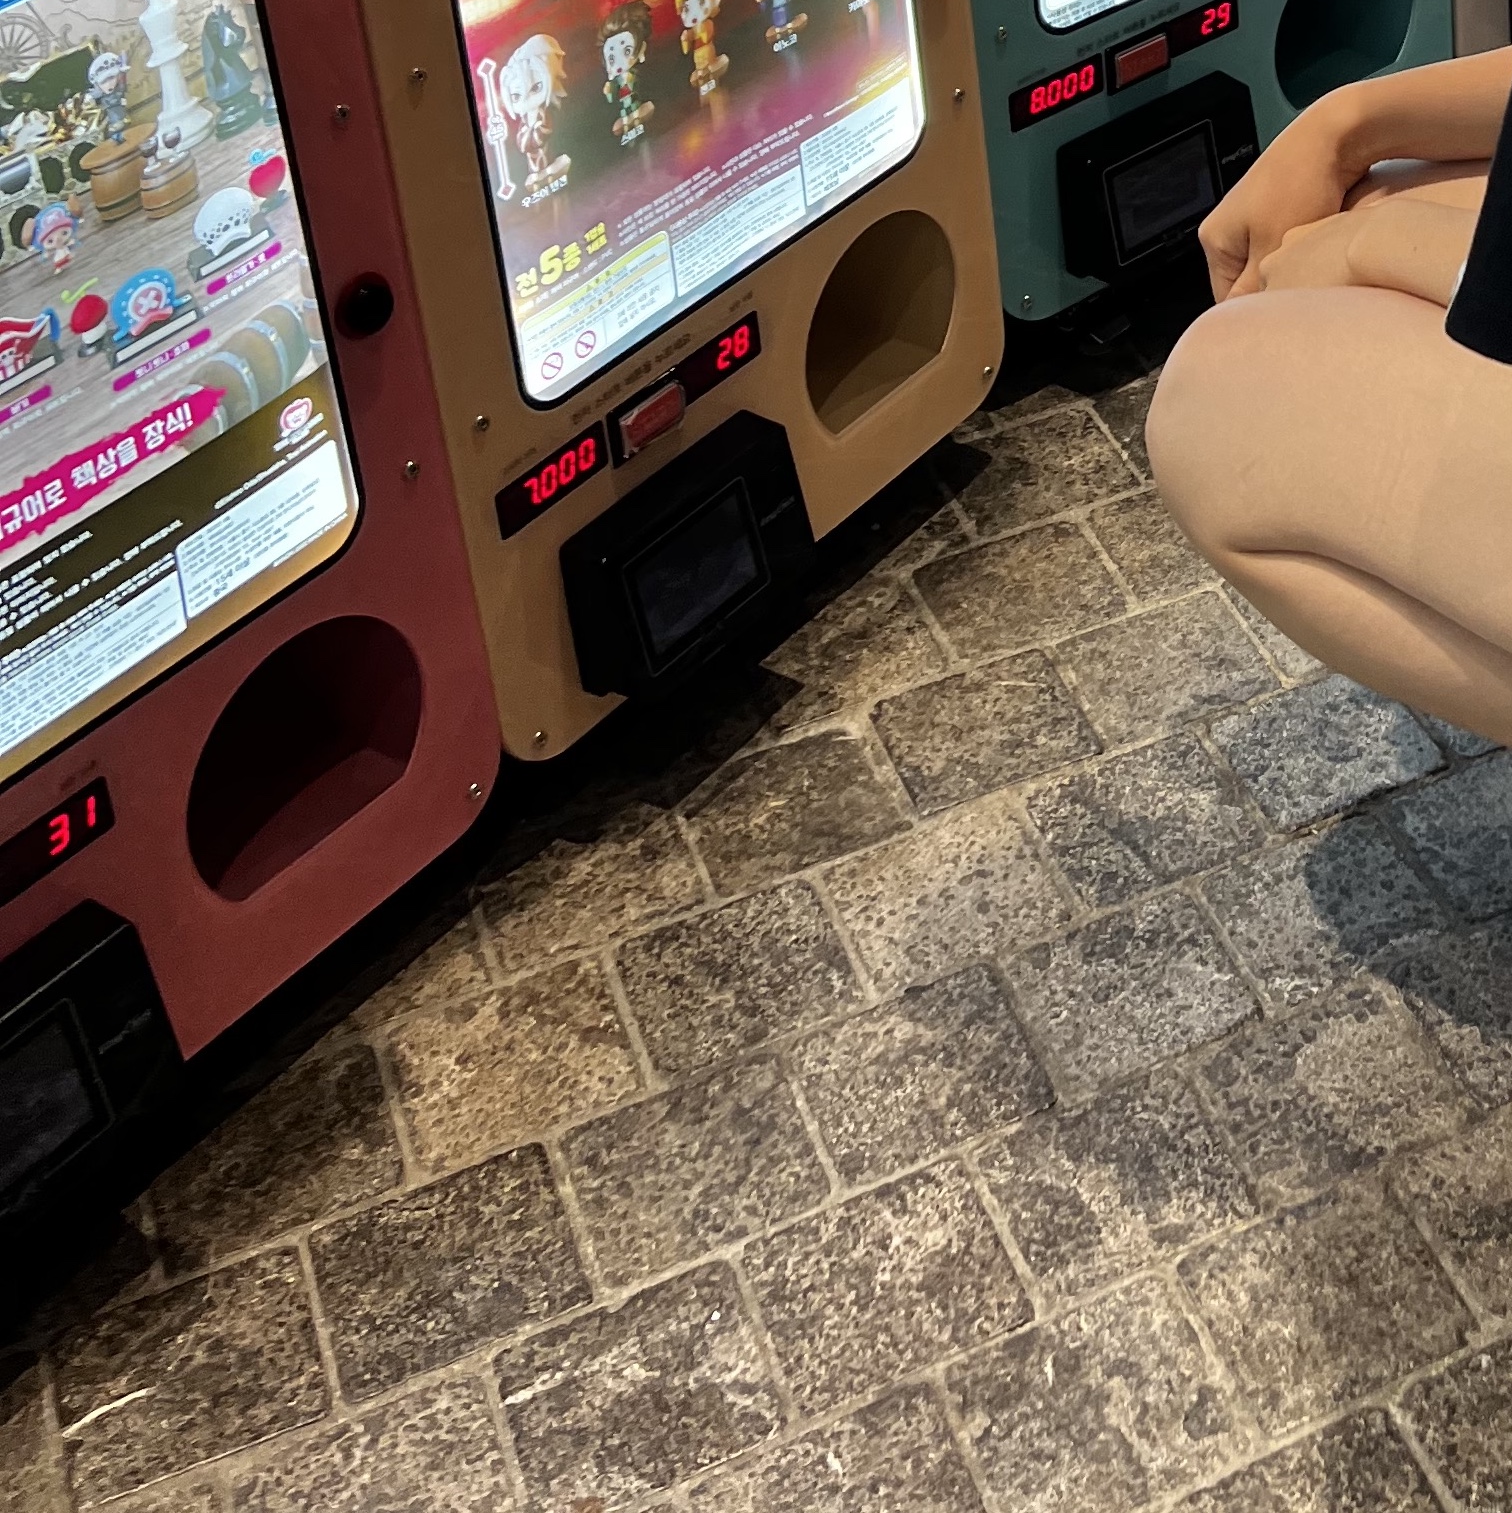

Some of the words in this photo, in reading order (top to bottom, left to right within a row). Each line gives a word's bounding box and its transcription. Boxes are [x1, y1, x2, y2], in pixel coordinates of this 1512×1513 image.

[1201, 2, 1232, 36] 29
[715, 324, 750, 371] 28
[0, 478, 68, 539] 규어로
[70, 436, 139, 489] 책상을
[141, 402, 194, 450] 장식!
[48, 796, 97, 856] 31
